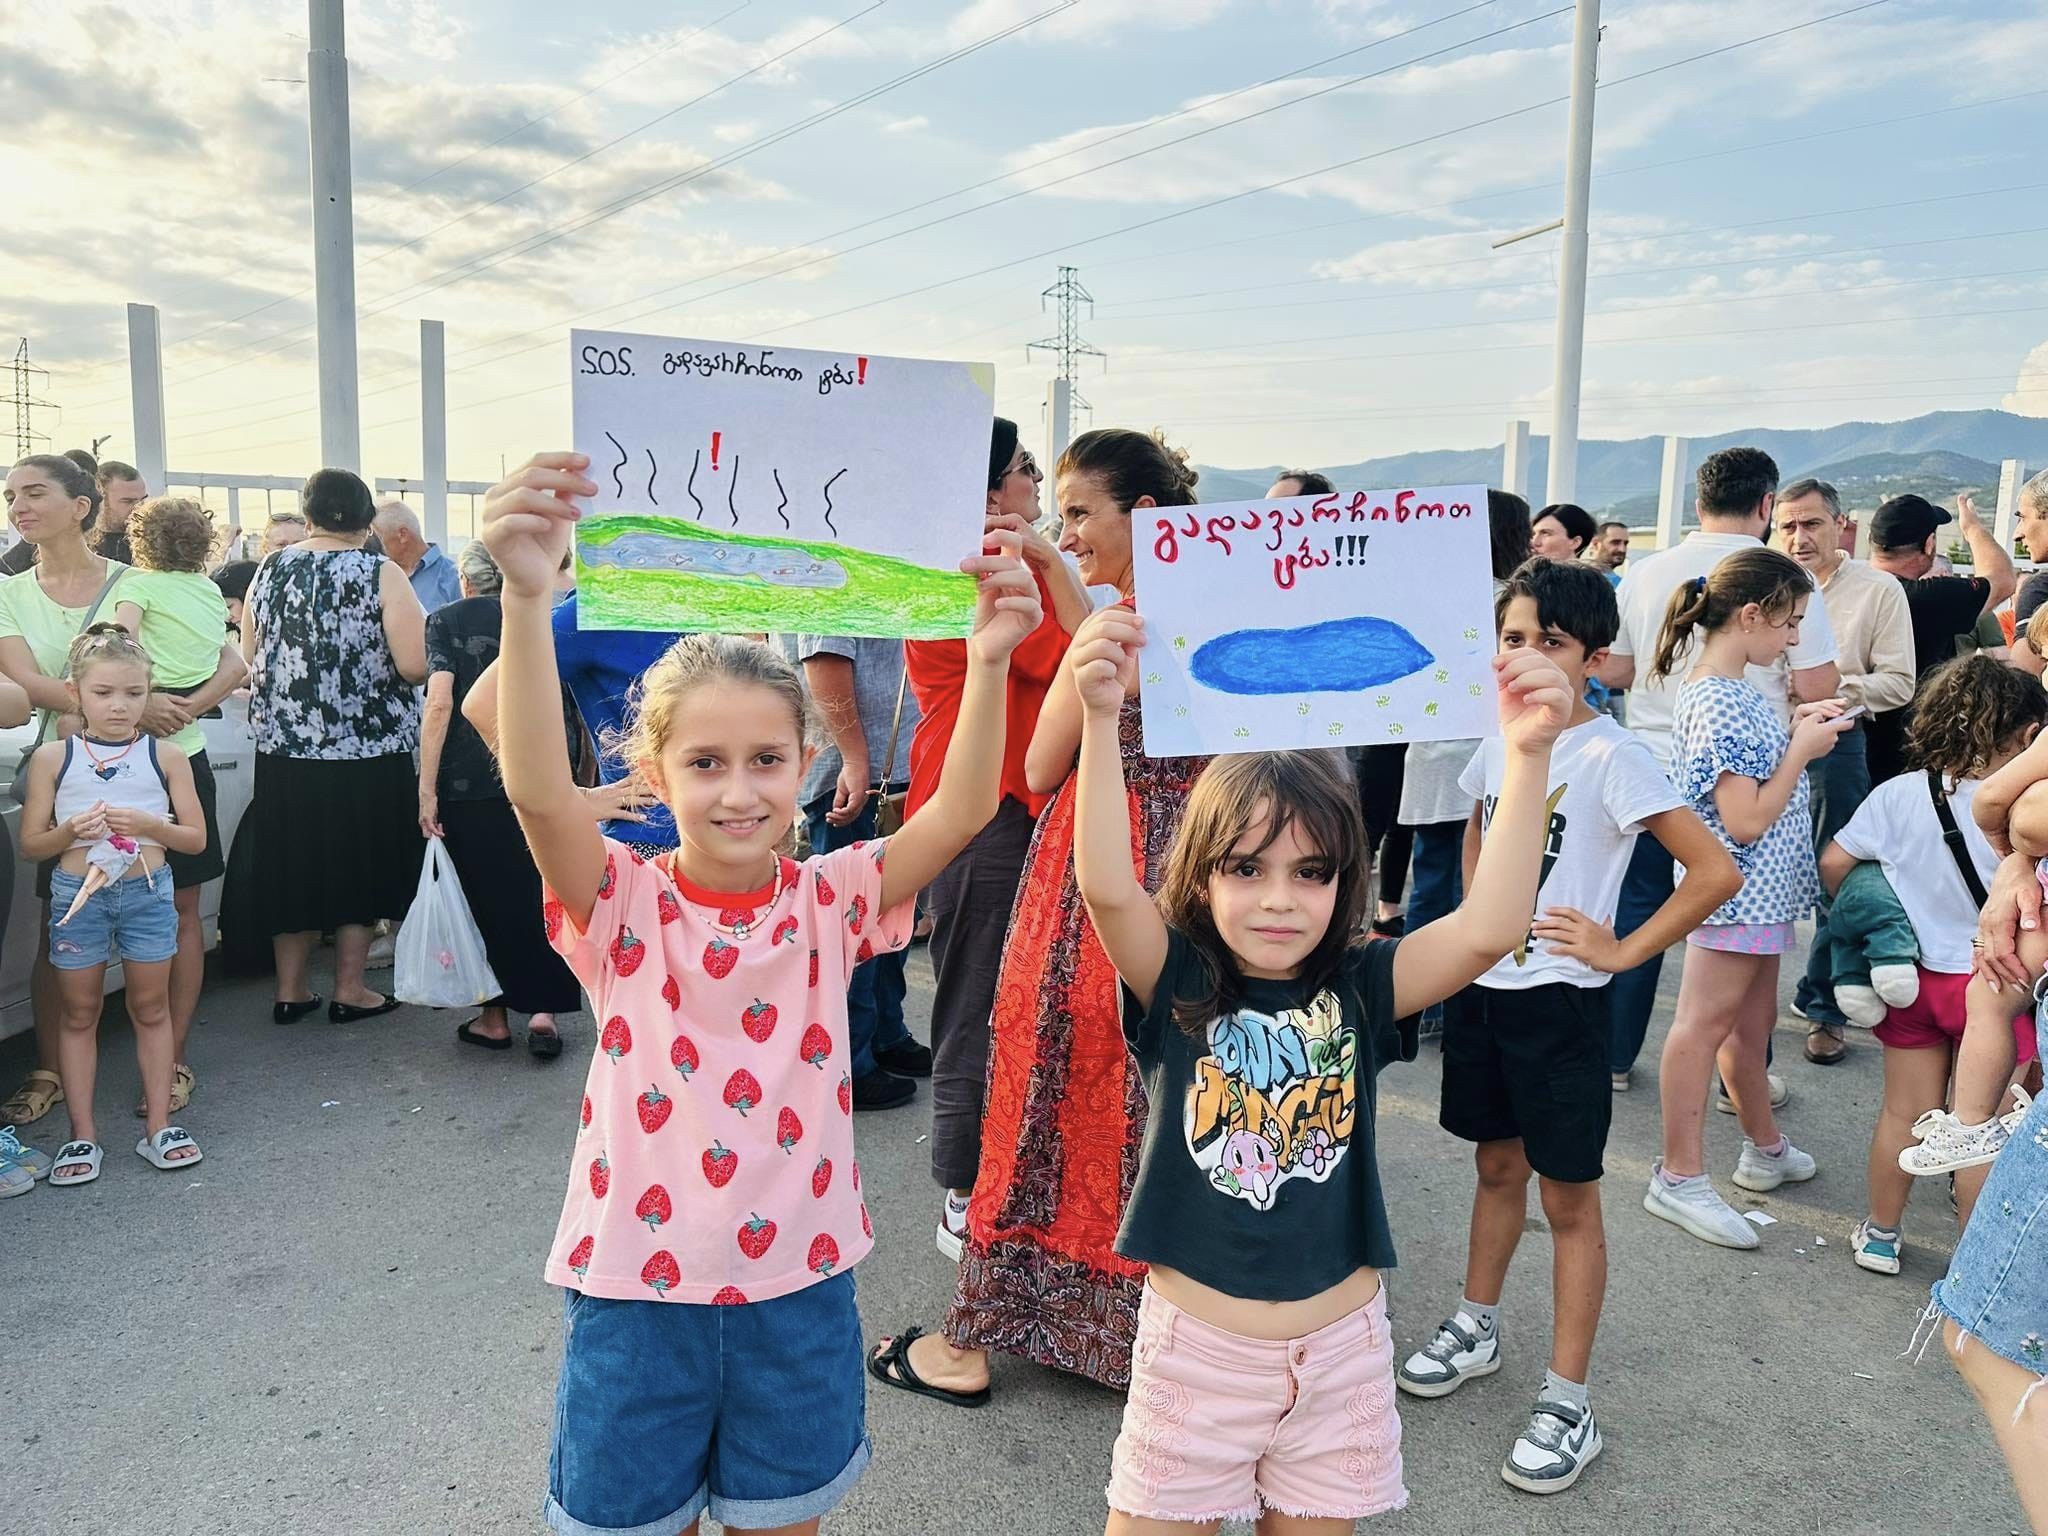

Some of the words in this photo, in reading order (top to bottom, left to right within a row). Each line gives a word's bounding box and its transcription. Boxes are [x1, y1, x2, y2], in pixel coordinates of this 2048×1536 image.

[663, 351, 803, 381] გადავარჩინოთ
[819, 356, 868, 394] ტბა!
[1154, 489, 1472, 563] გადავარჩინოთ
[1273, 535, 1369, 590] ტბა!!!
